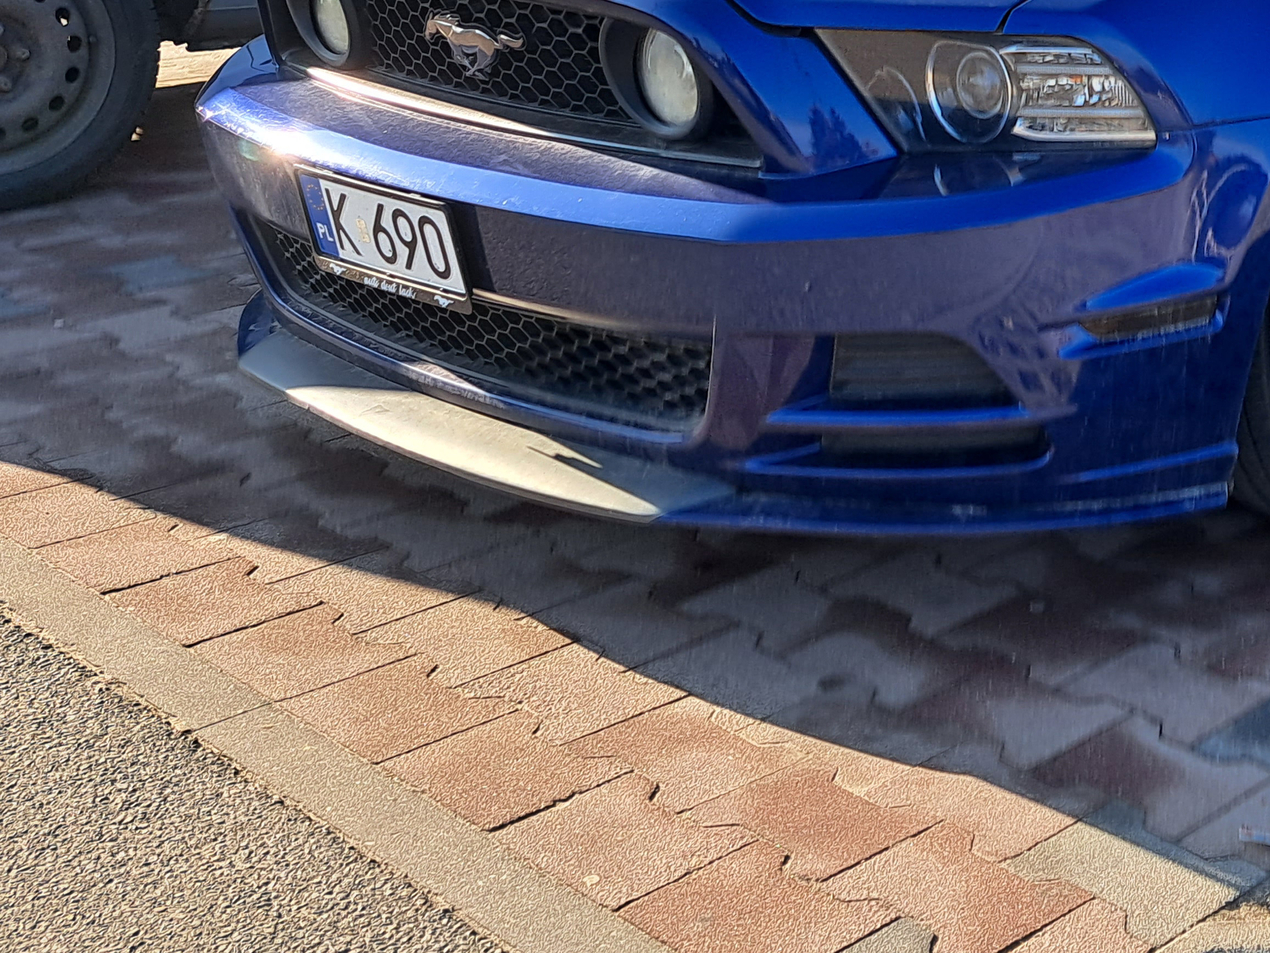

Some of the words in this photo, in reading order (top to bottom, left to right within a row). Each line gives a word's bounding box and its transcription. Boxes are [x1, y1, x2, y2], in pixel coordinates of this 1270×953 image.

[316, 222, 334, 242] PL
[325, 187, 363, 257] K
[372, 202, 451, 280] 690
